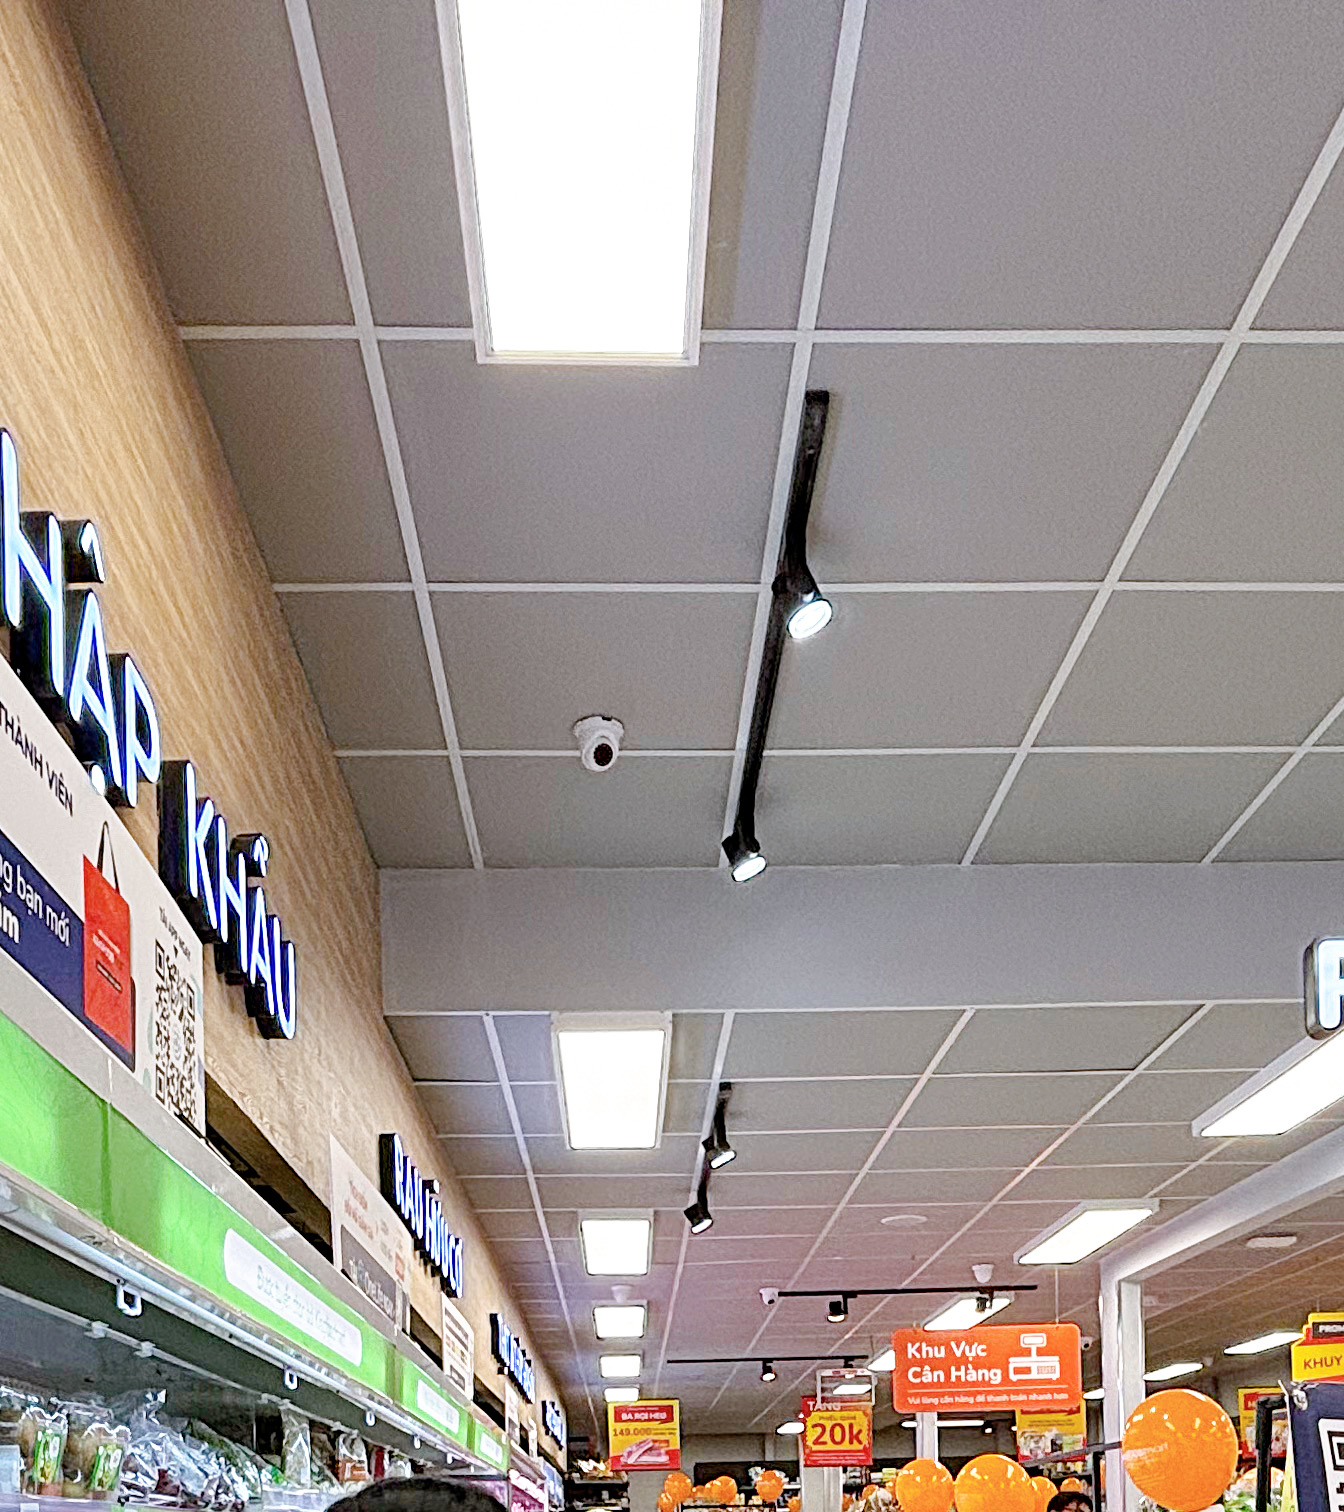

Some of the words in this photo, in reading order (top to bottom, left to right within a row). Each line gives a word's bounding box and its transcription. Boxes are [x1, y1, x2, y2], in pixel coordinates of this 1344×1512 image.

[45, 764, 74, 816] VIÊN
[16, 864, 43, 918] bạn
[46, 903, 71, 948] mới
[184, 762, 296, 1039] KHẨU
[907, 1342, 945, 1359] Khu
[950, 1341, 987, 1360] Vực
[907, 1367, 946, 1384] Cân
[950, 1363, 1002, 1384] Hàng
[811, 1422, 863, 1446] 20k
